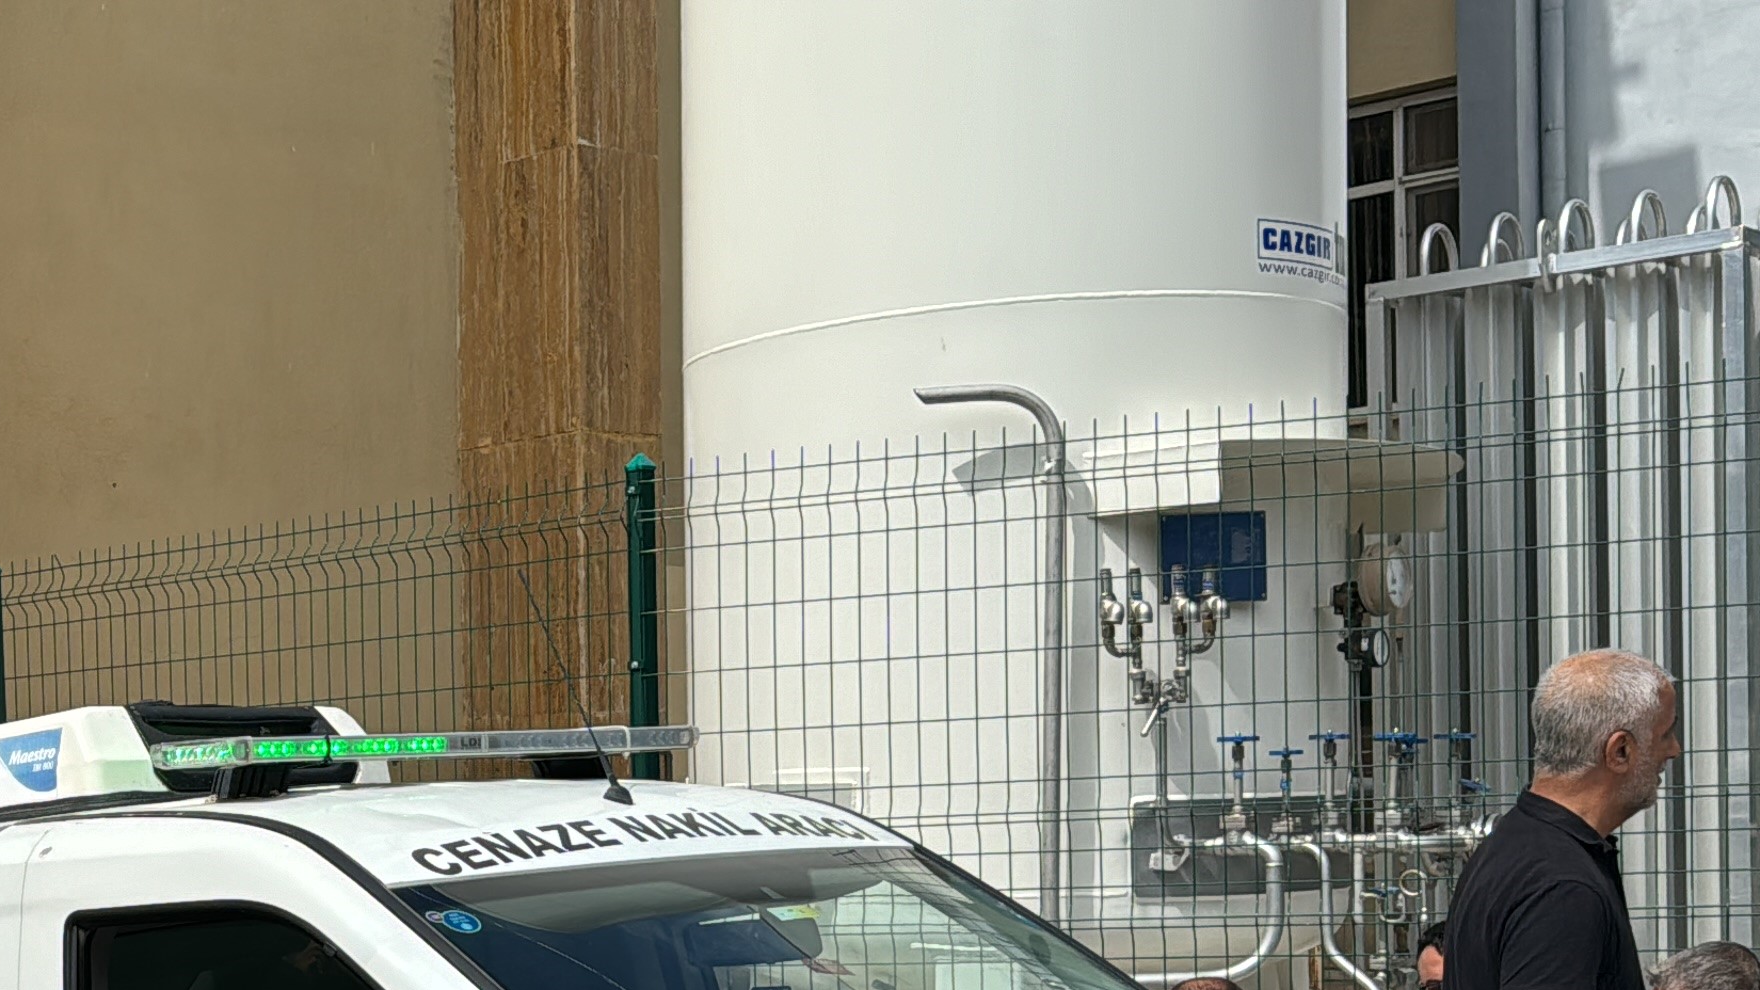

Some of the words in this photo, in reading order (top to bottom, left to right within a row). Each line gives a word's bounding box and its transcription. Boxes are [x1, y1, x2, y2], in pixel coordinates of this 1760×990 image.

[1262, 227, 1331, 261] CAZGIR
[8, 746, 57, 766] Maestro
[411, 819, 624, 876] CENAZE
[607, 807, 763, 843] NAKİL
[749, 811, 880, 842] ARACI
